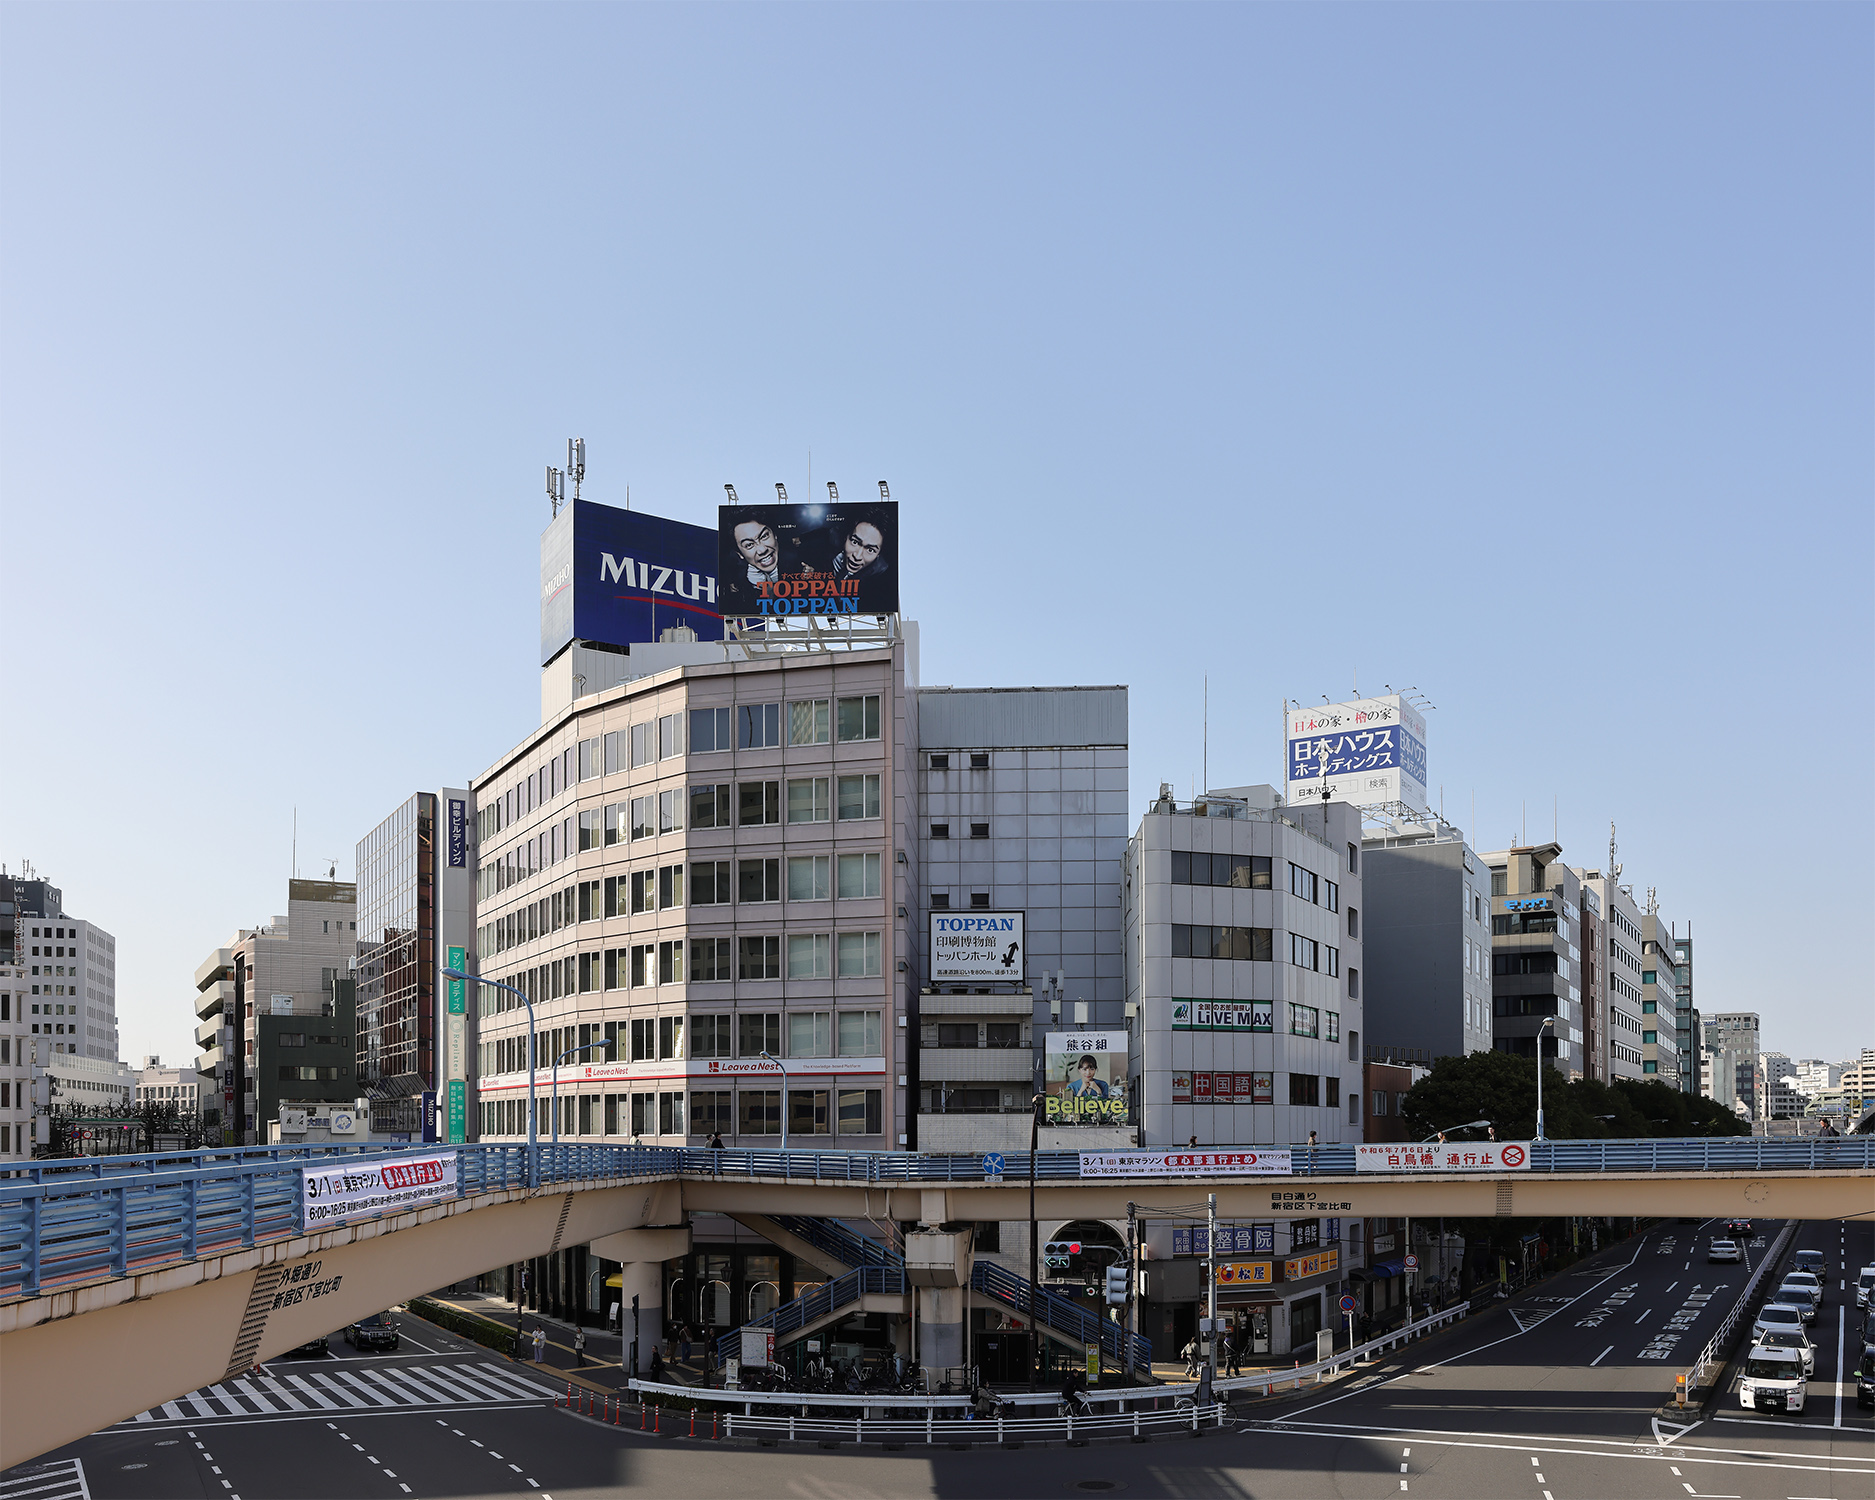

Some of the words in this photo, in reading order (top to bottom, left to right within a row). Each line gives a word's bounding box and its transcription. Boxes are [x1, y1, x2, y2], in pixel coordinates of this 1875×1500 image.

[544, 563, 570, 598] MIZUHO
[600, 551, 719, 604] MIZUH
[756, 579, 860, 598] TOPPA!!!
[756, 597, 860, 615] TOPPAN
[1295, 729, 1394, 762] 日本ハウス
[1369, 778, 1388, 789] 検索
[1298, 785, 1338, 797] 日本ハウス
[936, 918, 1015, 932] TOPPAN
[936, 935, 997, 948] 印刷博物館
[937, 951, 996, 961] トッパンホール
[1237, 1012, 1272, 1026] MAX
[1066, 1038, 1108, 1051] 熊谷組
[592, 1068, 609, 1077] Leave
[614, 1067, 629, 1075] Nest
[722, 1062, 750, 1071] Leave
[758, 1062, 780, 1071] Nest
[1195, 1076, 1250, 1093] 中国語
[1360, 1146, 1441, 1154] 令和6年7月6日より
[1082, 1157, 1104, 1166] 3/1
[1118, 1157, 1162, 1166] 東京マラソン
[1168, 1154, 1254, 1166] 都心部通行止め
[1388, 1153, 1434, 1166] 白鳥橋
[1446, 1153, 1494, 1165] 通行止
[307, 1176, 332, 1198] 3/1
[342, 1173, 380, 1193] 東京マラソン
[383, 1162, 442, 1189] 都心部通行止め
[1271, 1192, 1317, 1200] 目白通り
[1271, 1202, 1352, 1211] 新宿区下宮比町
[1216, 1230, 1272, 1249] 整骨院
[278, 1260, 322, 1287] 外堀通り
[1237, 1267, 1265, 1280] 松屋
[271, 1275, 343, 1311] 新宿区下宮比町
[1637, 1334, 1682, 1360] 後楽園
